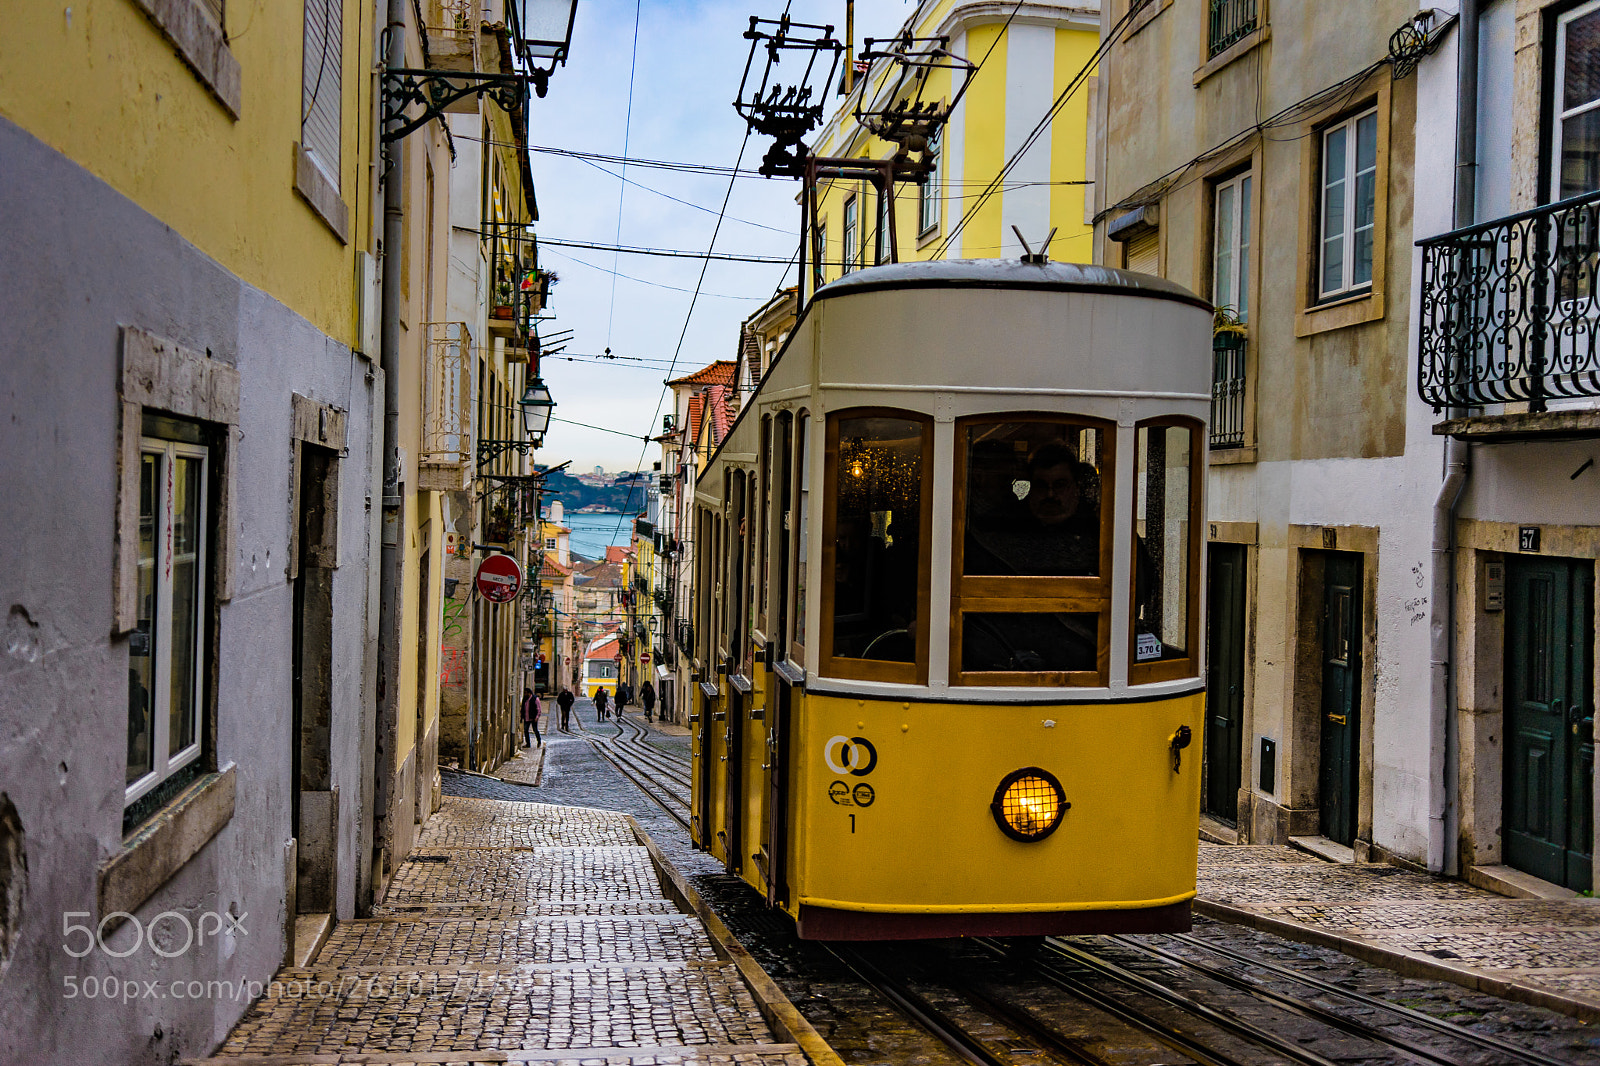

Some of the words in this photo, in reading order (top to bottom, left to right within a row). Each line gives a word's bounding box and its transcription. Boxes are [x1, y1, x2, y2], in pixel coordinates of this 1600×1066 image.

[1522, 529, 1535, 549] 57
[1138, 645, 1154, 655] 3.70
[1155, 644, 1160, 653] €
[849, 814, 855, 833] 1
